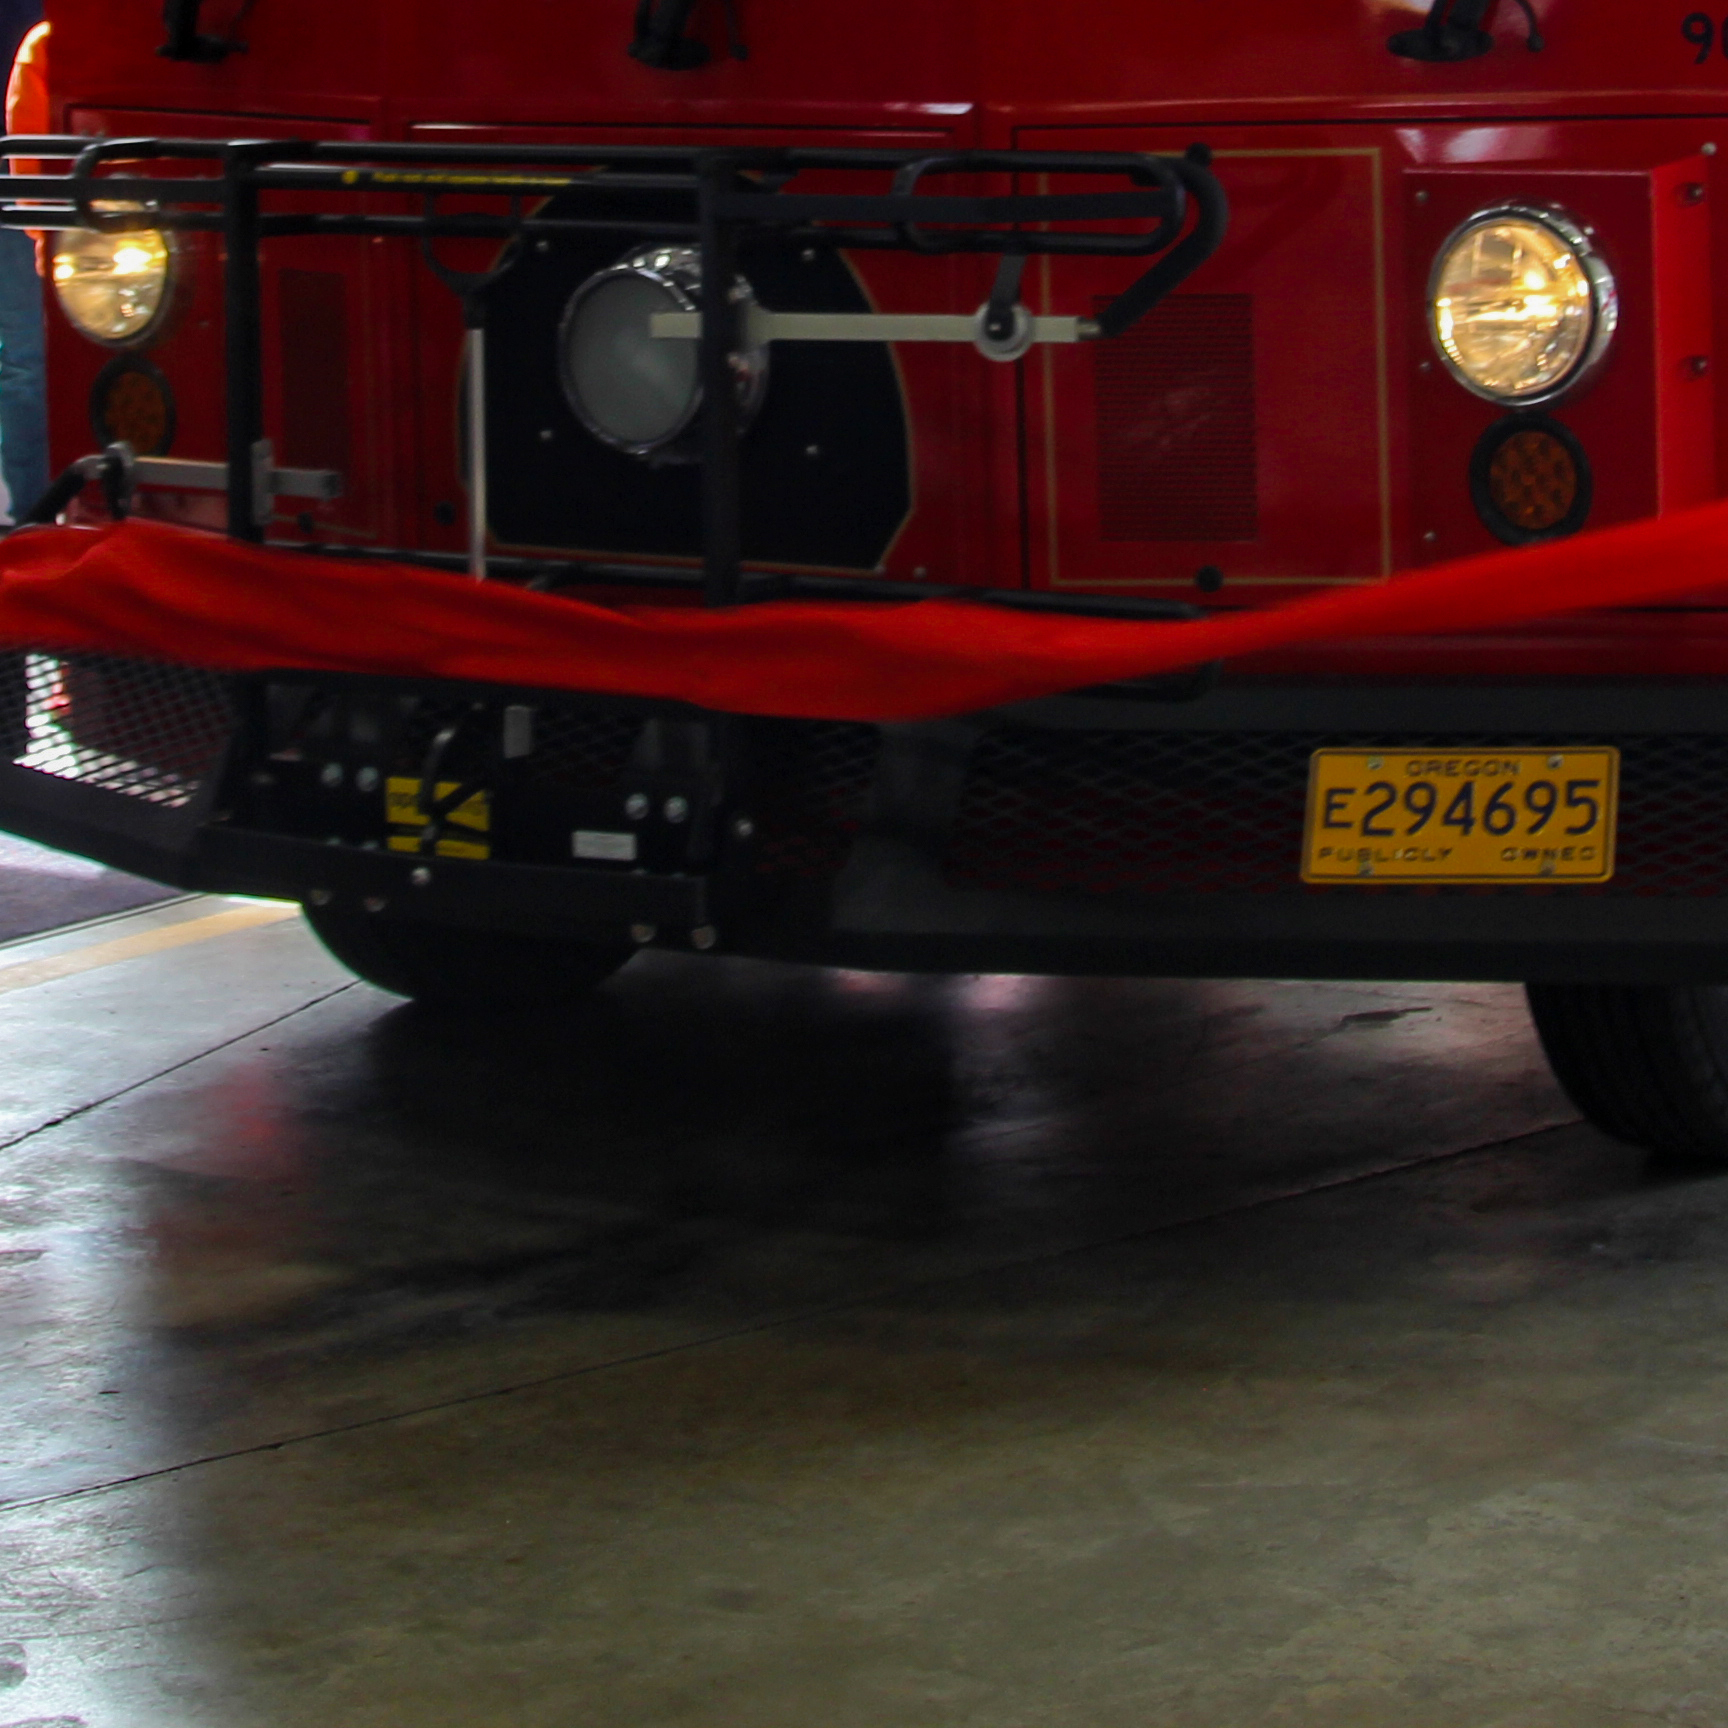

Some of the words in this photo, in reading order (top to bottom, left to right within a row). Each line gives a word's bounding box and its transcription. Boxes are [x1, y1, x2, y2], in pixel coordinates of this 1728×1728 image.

[1405, 759, 1521, 778] OREGON
[1322, 780, 1601, 838] E294695
[1317, 846, 1454, 863] PUBLICLY
[1500, 846, 1597, 863] OWNED
